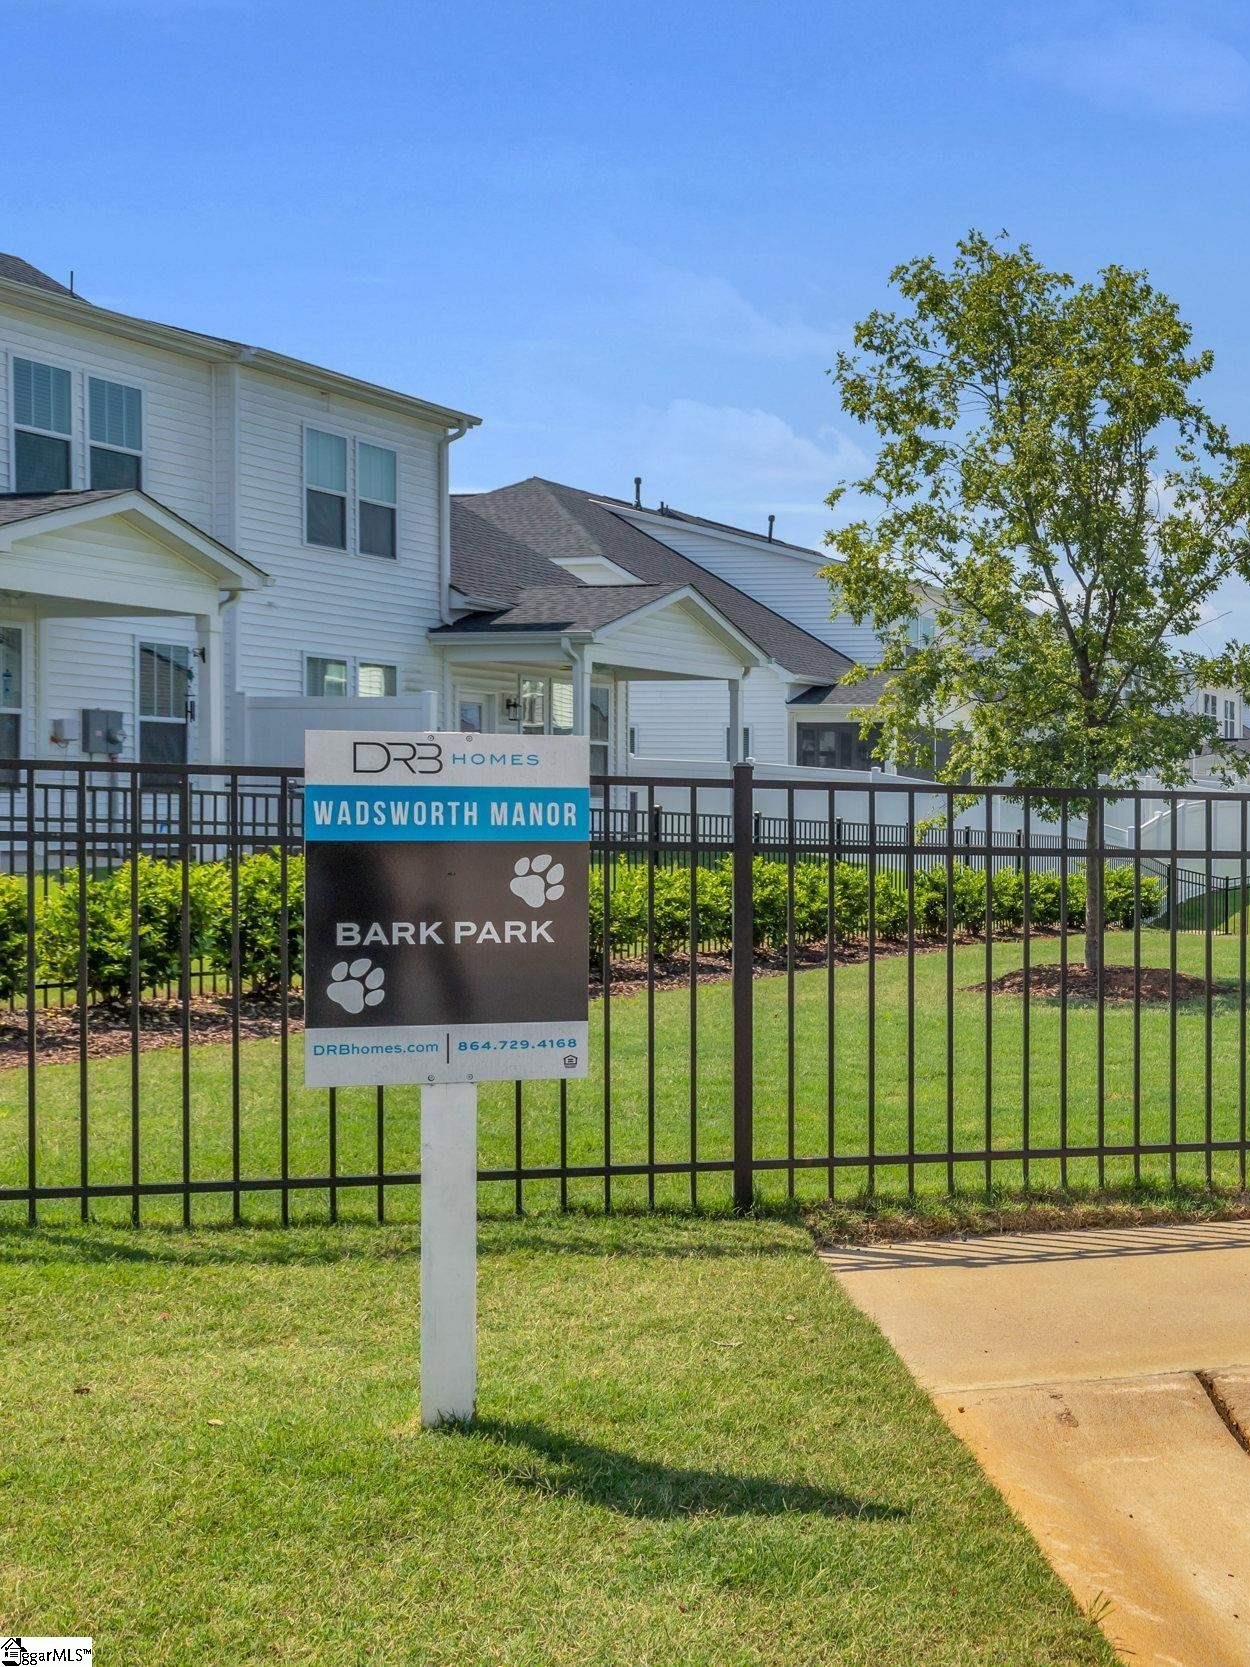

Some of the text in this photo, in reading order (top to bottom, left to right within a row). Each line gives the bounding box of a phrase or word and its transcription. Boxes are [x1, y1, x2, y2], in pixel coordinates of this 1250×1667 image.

[352, 741, 540, 775] DRB HOMES
[313, 800, 577, 827] WADSWORTH MANOR
[336, 920, 555, 946] BARK PARK
[313, 1037, 578, 1057] DRBhomes.com 864.729.4168
